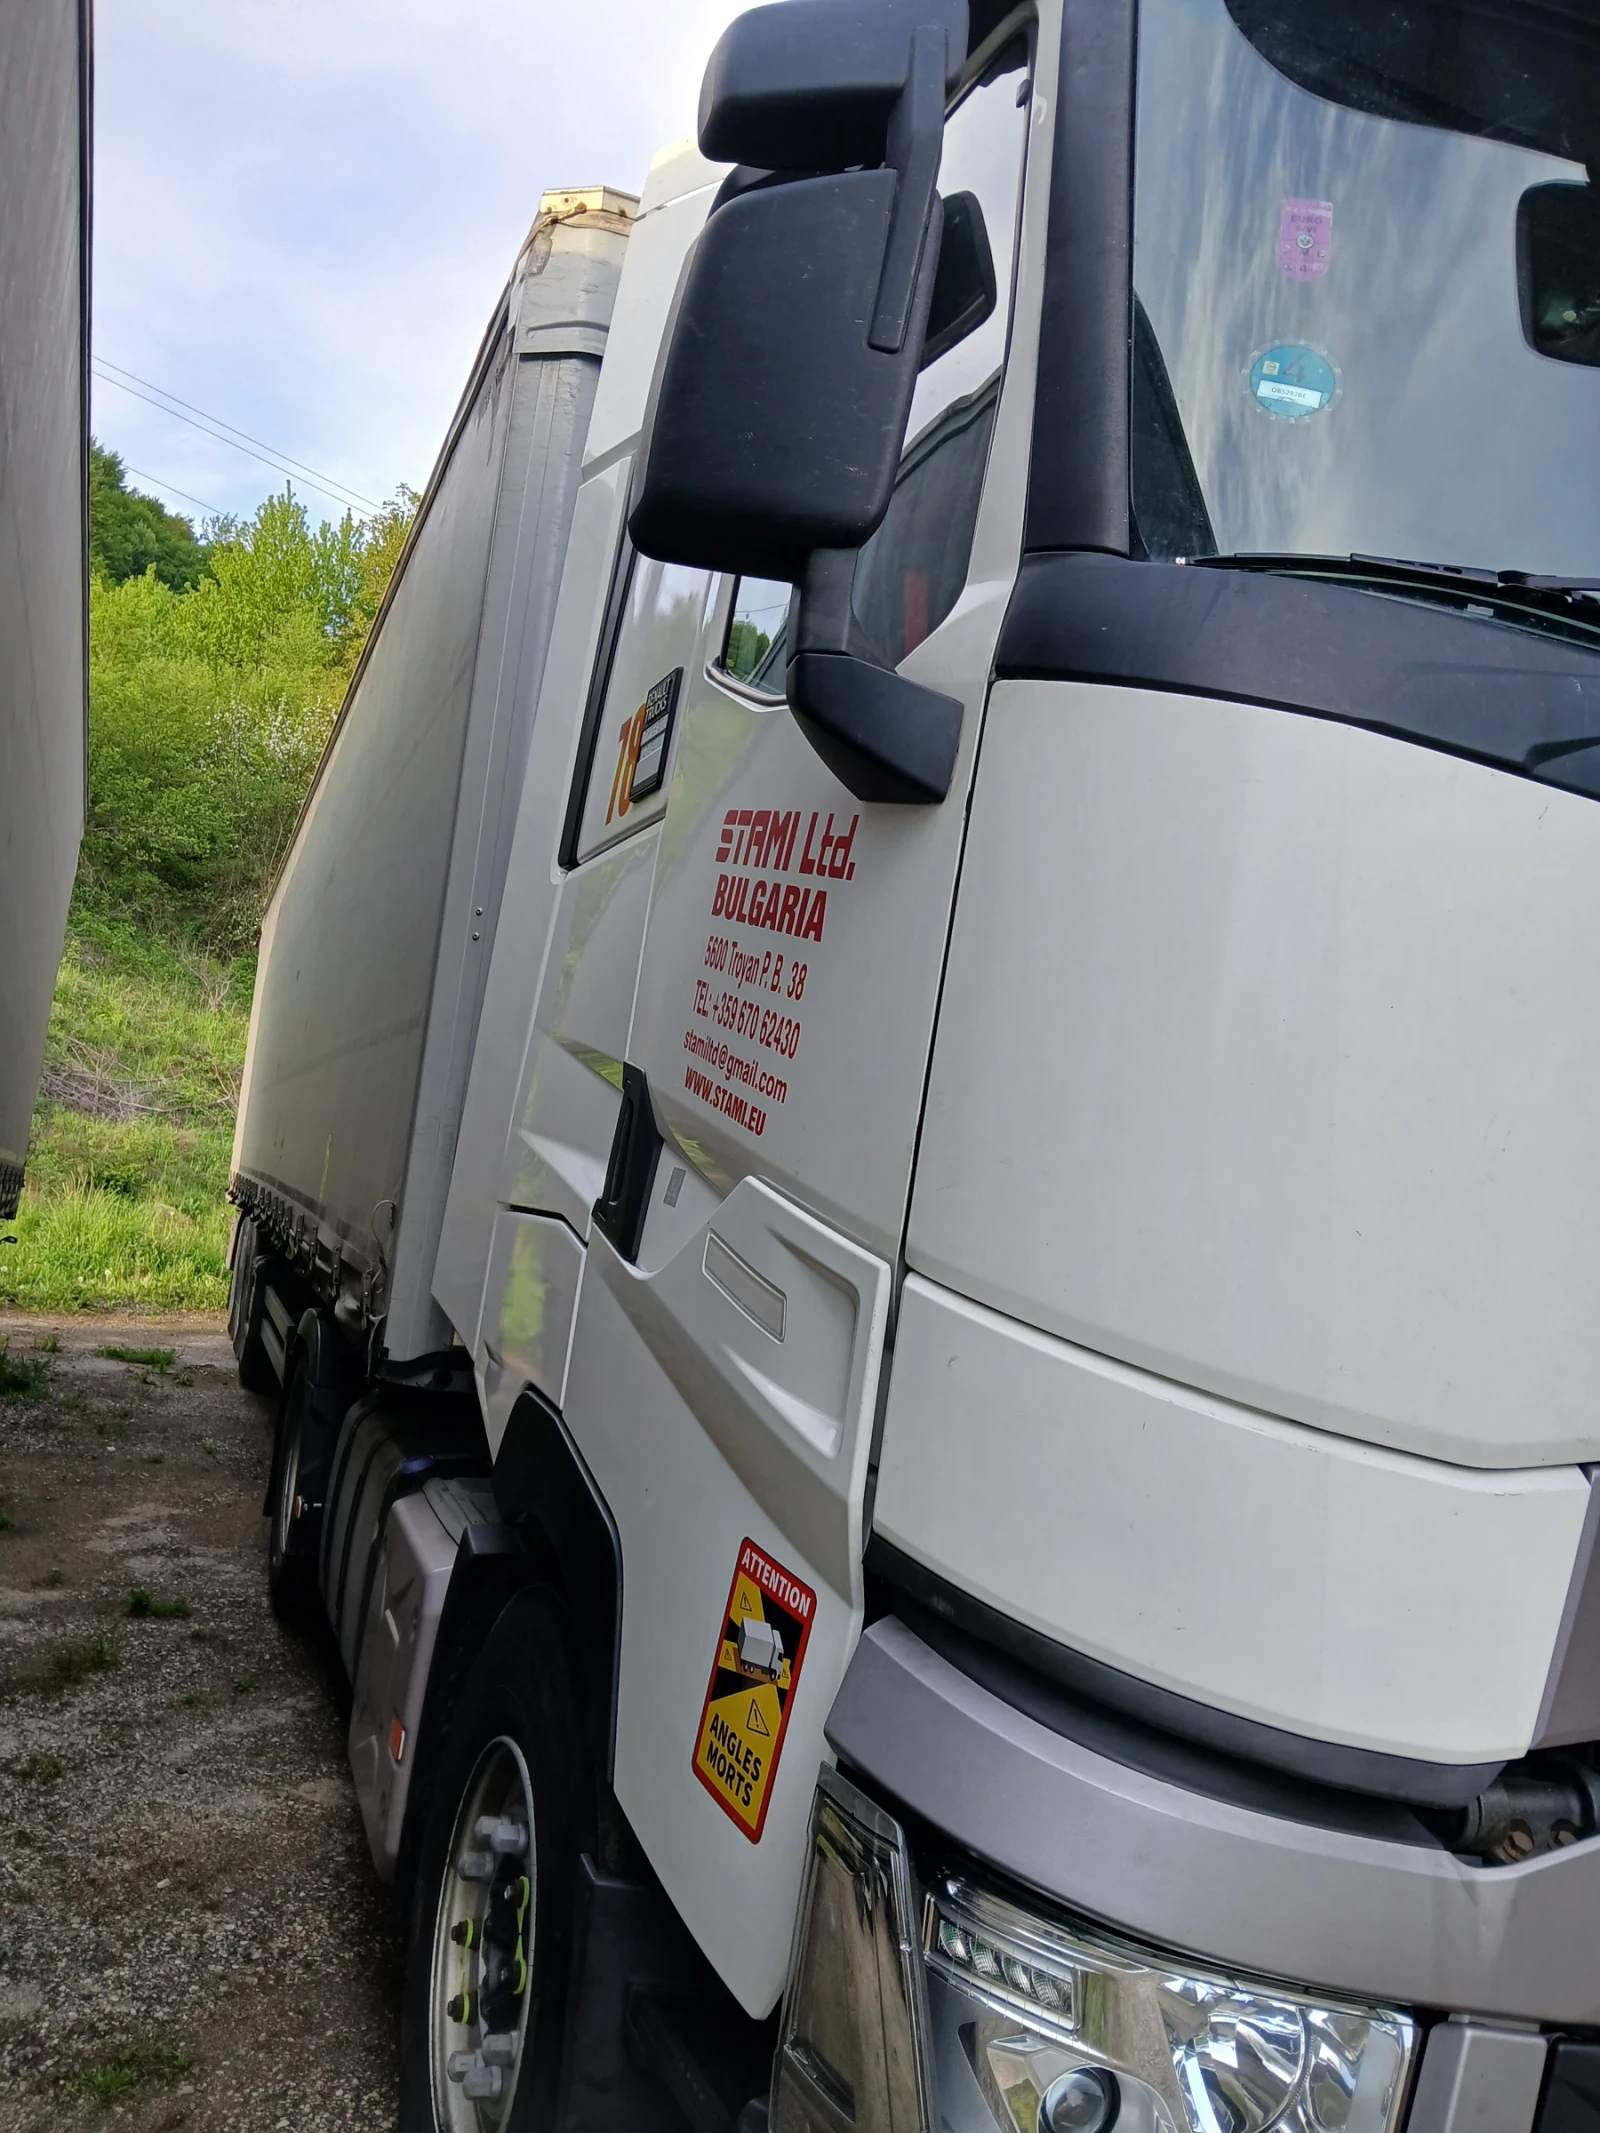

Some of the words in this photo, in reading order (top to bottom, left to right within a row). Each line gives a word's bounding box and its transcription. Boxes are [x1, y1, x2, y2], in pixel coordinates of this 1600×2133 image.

[1291, 214, 1322, 225] EURO
[1282, 352, 1305, 382] 4
[645, 695, 668, 724] TRUCKS
[715, 809, 801, 871] STAMI
[799, 811, 860, 881] Ltd.
[711, 874, 828, 942] BULGARIA
[704, 935, 729, 972] 5600
[728, 941, 760, 989] Troyan
[787, 961, 808, 1001] 38
[712, 992, 739, 1030] +359
[737, 1000, 760, 1040] 670
[759, 1009, 801, 1060] 62430
[683, 1029, 788, 1104] stamiltd@gmail.com
[684, 1066, 767, 1136] WWW.STAMI.EU
[741, 1547, 812, 1618] ATTENTION
[706, 1740, 753, 1807] MORTS
[709, 1713, 762, 1782] ANGLES
